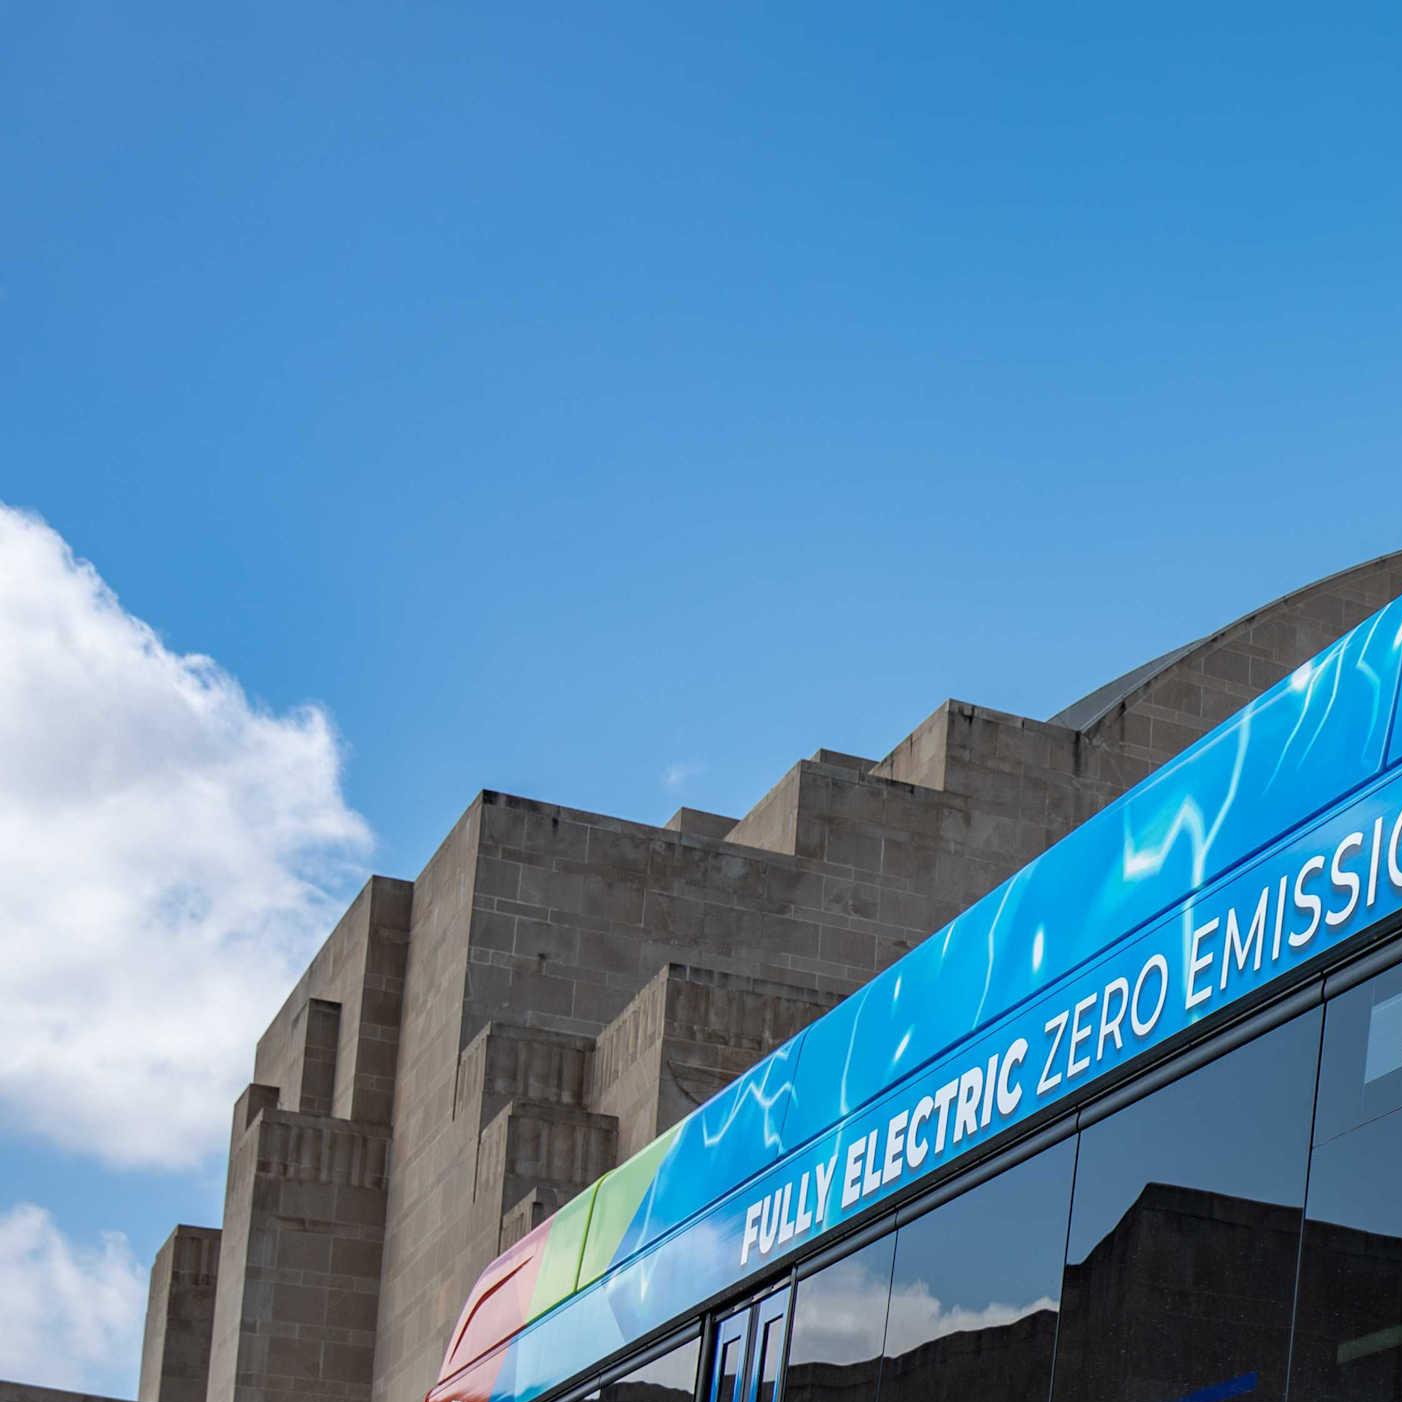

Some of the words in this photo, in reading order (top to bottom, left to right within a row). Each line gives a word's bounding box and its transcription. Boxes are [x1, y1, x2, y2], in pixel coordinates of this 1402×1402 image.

[740, 1155, 838, 1266] FULLY
[842, 1038, 1029, 1210] ELECTRIC
[1036, 953, 1169, 1095] ZERO
